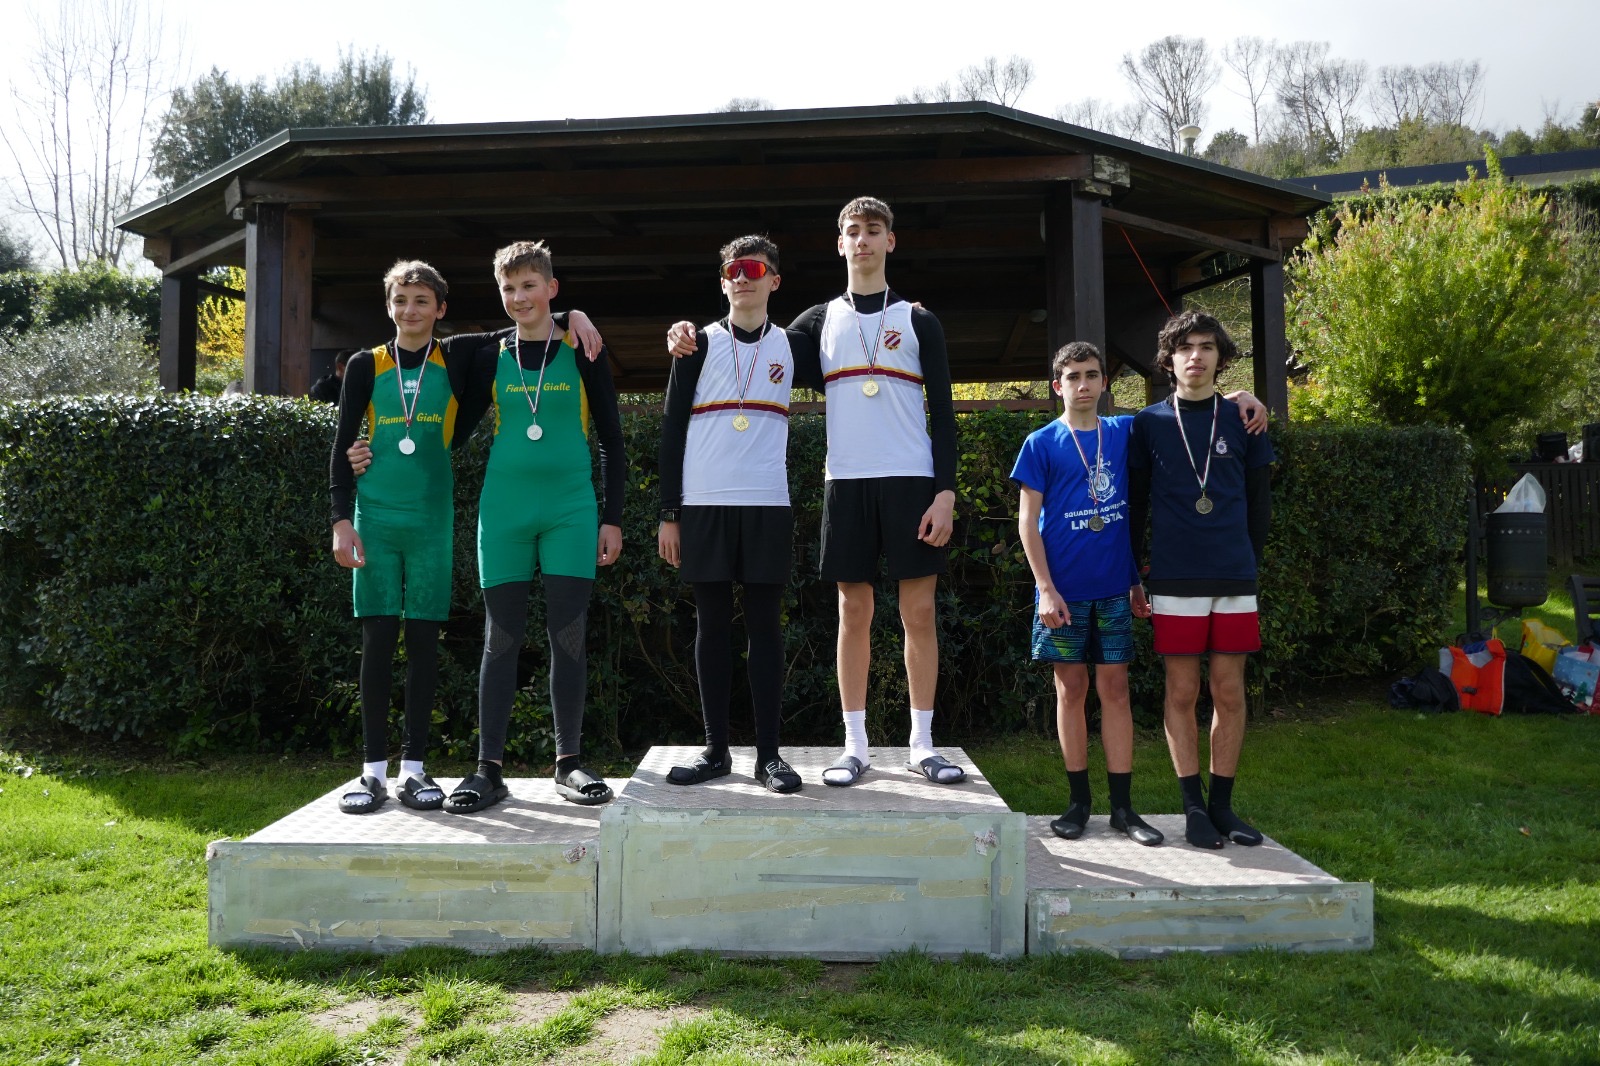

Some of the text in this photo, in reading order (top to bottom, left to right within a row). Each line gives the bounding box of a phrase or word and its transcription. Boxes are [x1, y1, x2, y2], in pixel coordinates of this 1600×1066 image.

[543, 382, 571, 391] Gialle
[378, 412, 443, 425] Fiamm Gialle
[1064, 509, 1098, 518] SQUADRA
